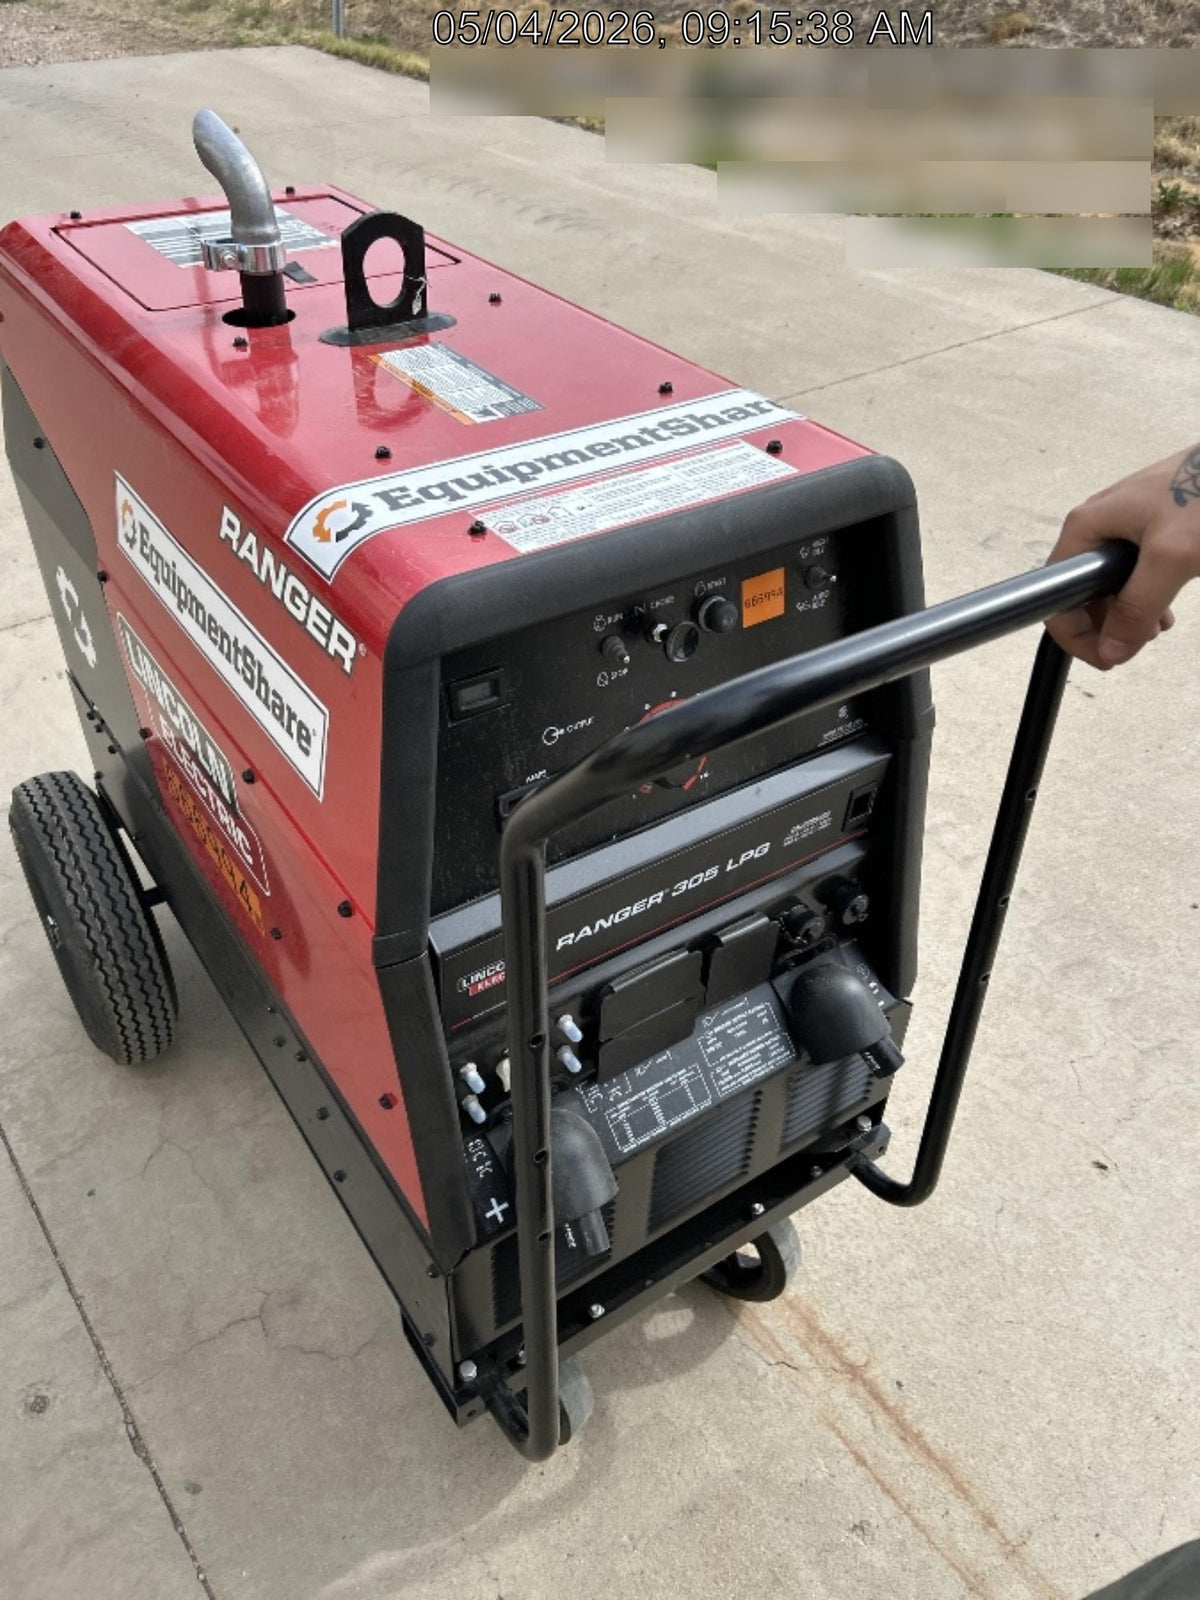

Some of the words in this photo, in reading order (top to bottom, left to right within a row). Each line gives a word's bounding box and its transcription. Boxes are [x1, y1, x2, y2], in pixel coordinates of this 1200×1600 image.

[371, 401, 774, 511] EquipmentShar
[137, 521, 312, 757] EquipmentShare
[126, 632, 233, 803] LINCOLN
[159, 712, 254, 866] ELECTRIC
[556, 890, 664, 951] RANGER
[671, 864, 720, 897] 305
[725, 842, 771, 872] LPG
[462, 961, 506, 988] LINCO
[477, 971, 506, 994] ELEC
